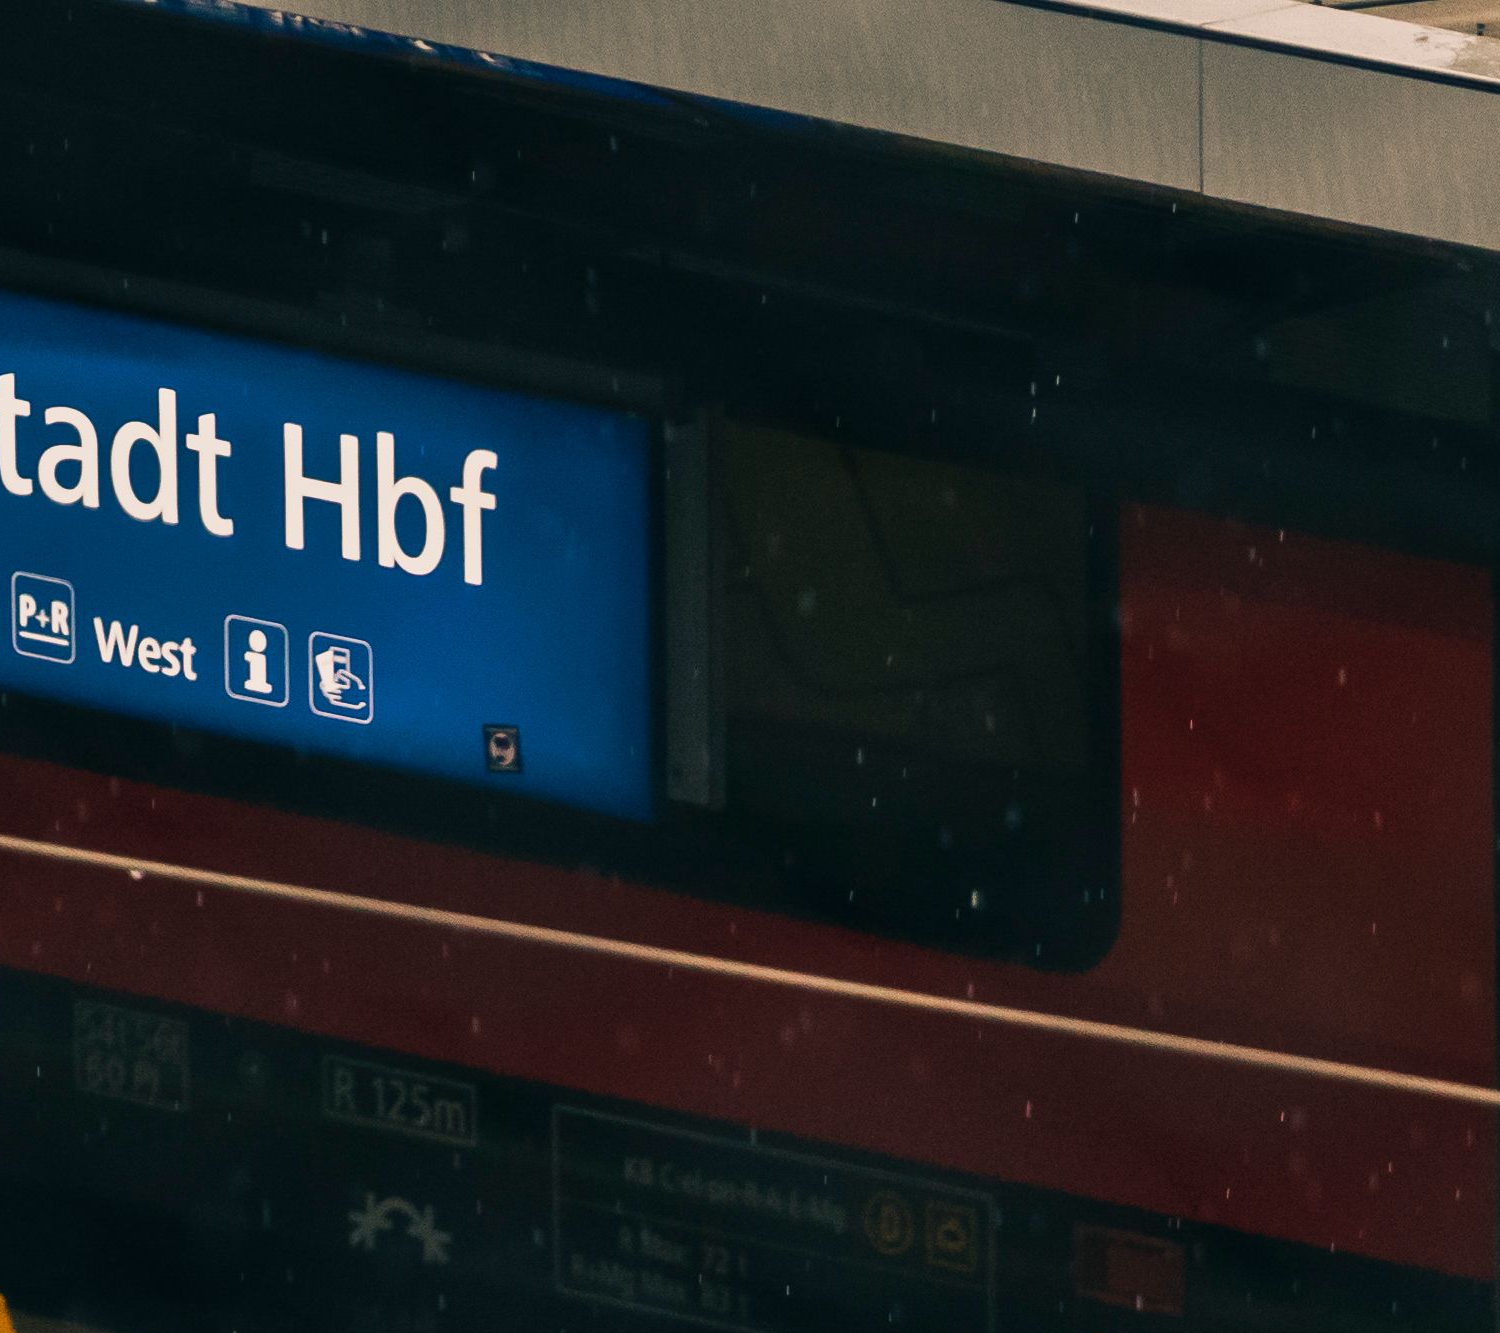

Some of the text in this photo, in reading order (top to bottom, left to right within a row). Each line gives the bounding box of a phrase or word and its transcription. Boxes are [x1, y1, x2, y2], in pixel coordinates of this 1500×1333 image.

[281, 422, 499, 586] Hbf
[19, 594, 70, 636] P+R
[93, 617, 198, 681] West
[333, 1067, 466, 1136] R 125m
